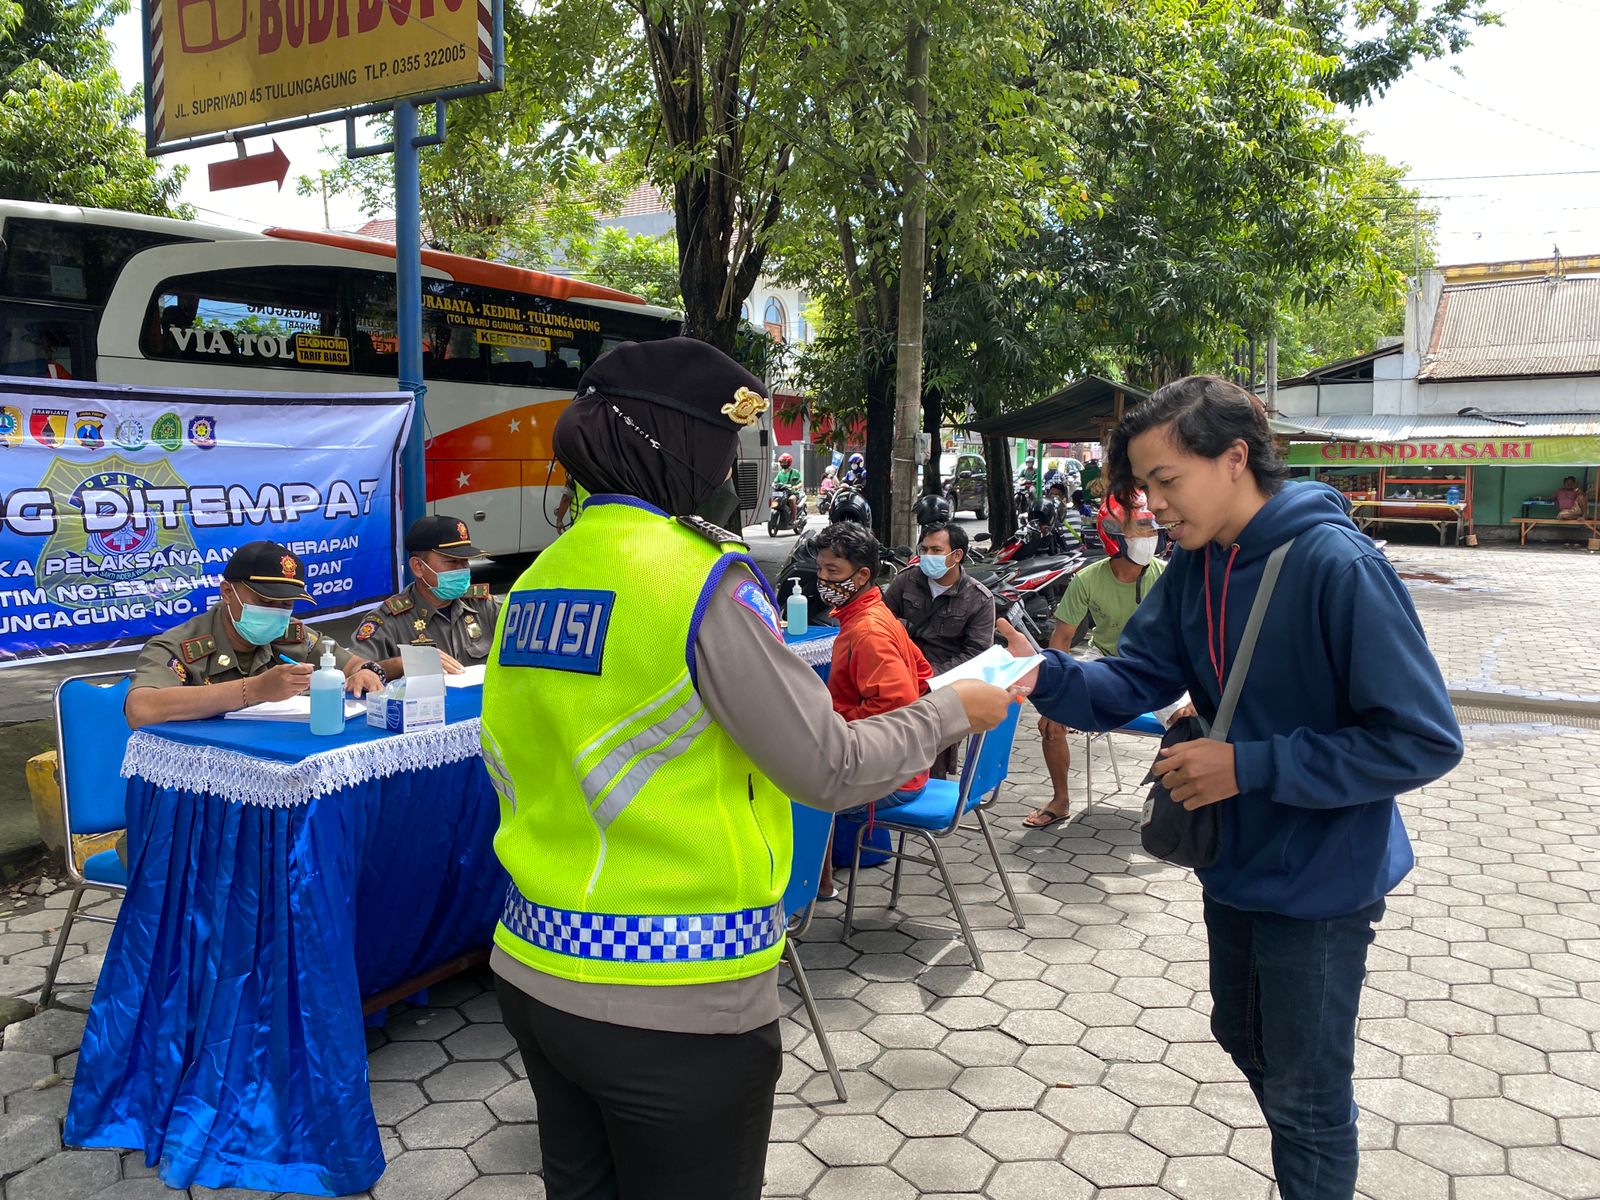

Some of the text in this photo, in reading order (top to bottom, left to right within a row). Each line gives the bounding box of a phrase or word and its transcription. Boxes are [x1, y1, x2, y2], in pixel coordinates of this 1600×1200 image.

[175, 44, 466, 118] JL. SUPRIYADI 45 TULUNGAGUNG TLP. 0355 322005
[421, 294, 601, 333] URABAYA KEDIRI TULUNGAGUNG
[446, 313, 466, 325] (TOL
[466, 316, 490, 328] WARU
[492, 319, 524, 332] GUNUNG
[529, 325, 544, 335] TOL
[544, 327, 575, 340] BANDAR)
[169, 327, 295, 360] VIA TOL
[298, 338, 347, 351] EKONOMI
[300, 350, 348, 363] TARIF BIASA
[481, 332, 547, 348] KERTOSONO
[1320, 441, 1535, 460] CHANDRASARI
[81, 480, 380, 533] DITEMPAT
[45, 547, 238, 576] PELAKSANAAN
[155, 573, 226, 593] TAHU
[307, 559, 342, 578] DAN
[155, 599, 198, 616] NO.
[312, 577, 353, 596] 2020
[501, 601, 603, 655] POLISI
